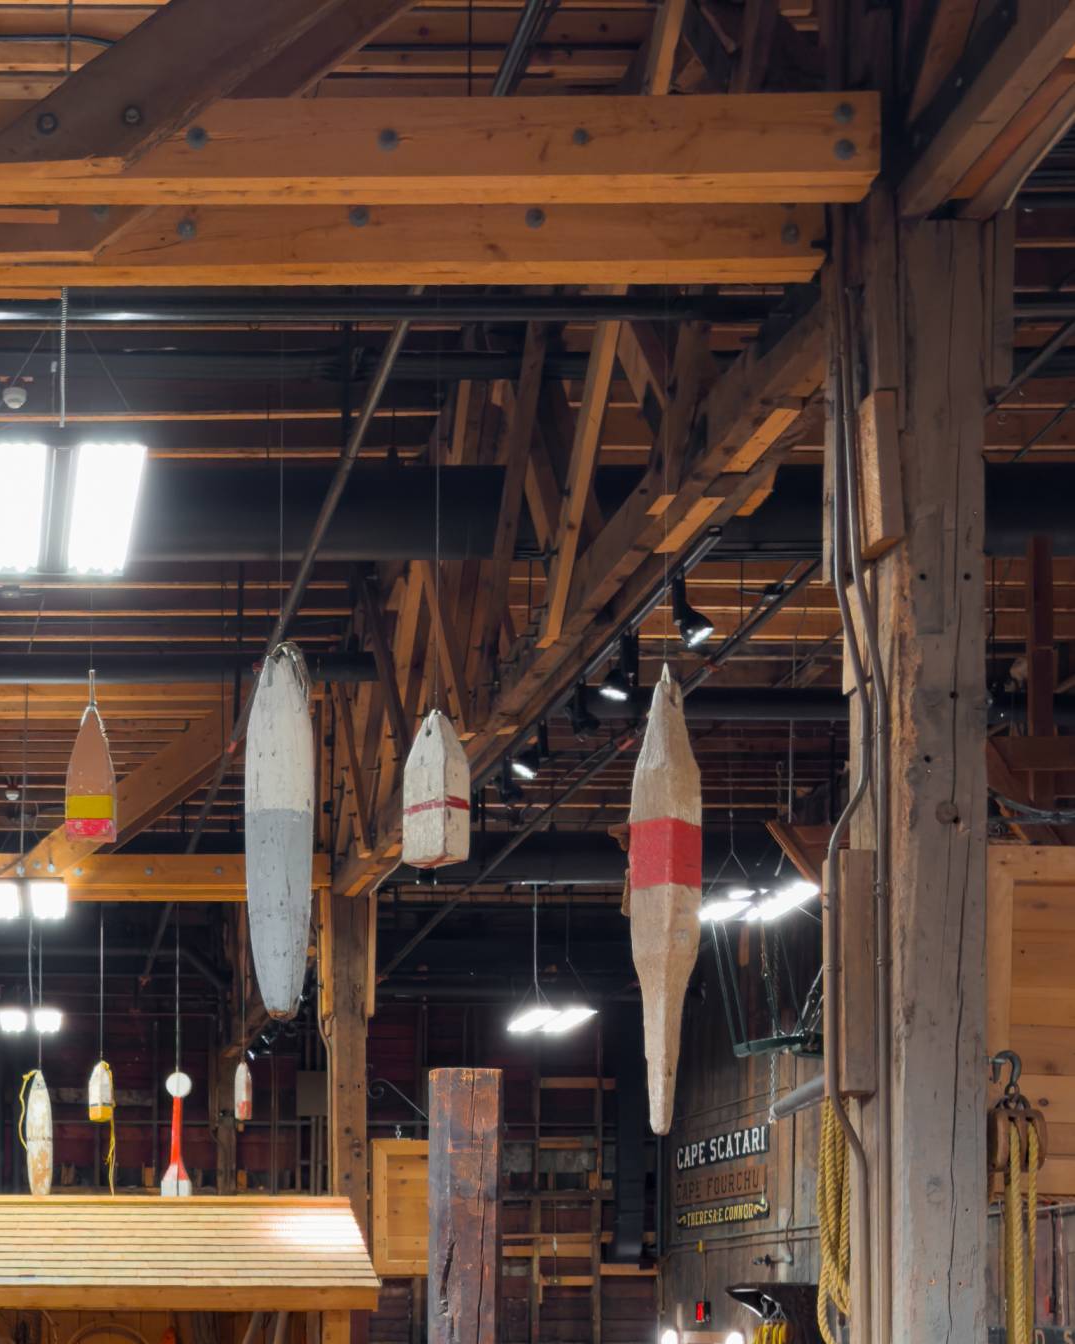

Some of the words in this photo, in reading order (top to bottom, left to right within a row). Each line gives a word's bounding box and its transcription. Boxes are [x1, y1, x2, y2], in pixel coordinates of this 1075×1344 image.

[677, 1141, 706, 1170] CAPE
[710, 1126, 765, 1161] SCATARI
[707, 1167, 759, 1197] FOURCHU
[725, 1203, 754, 1221] CONNOR
